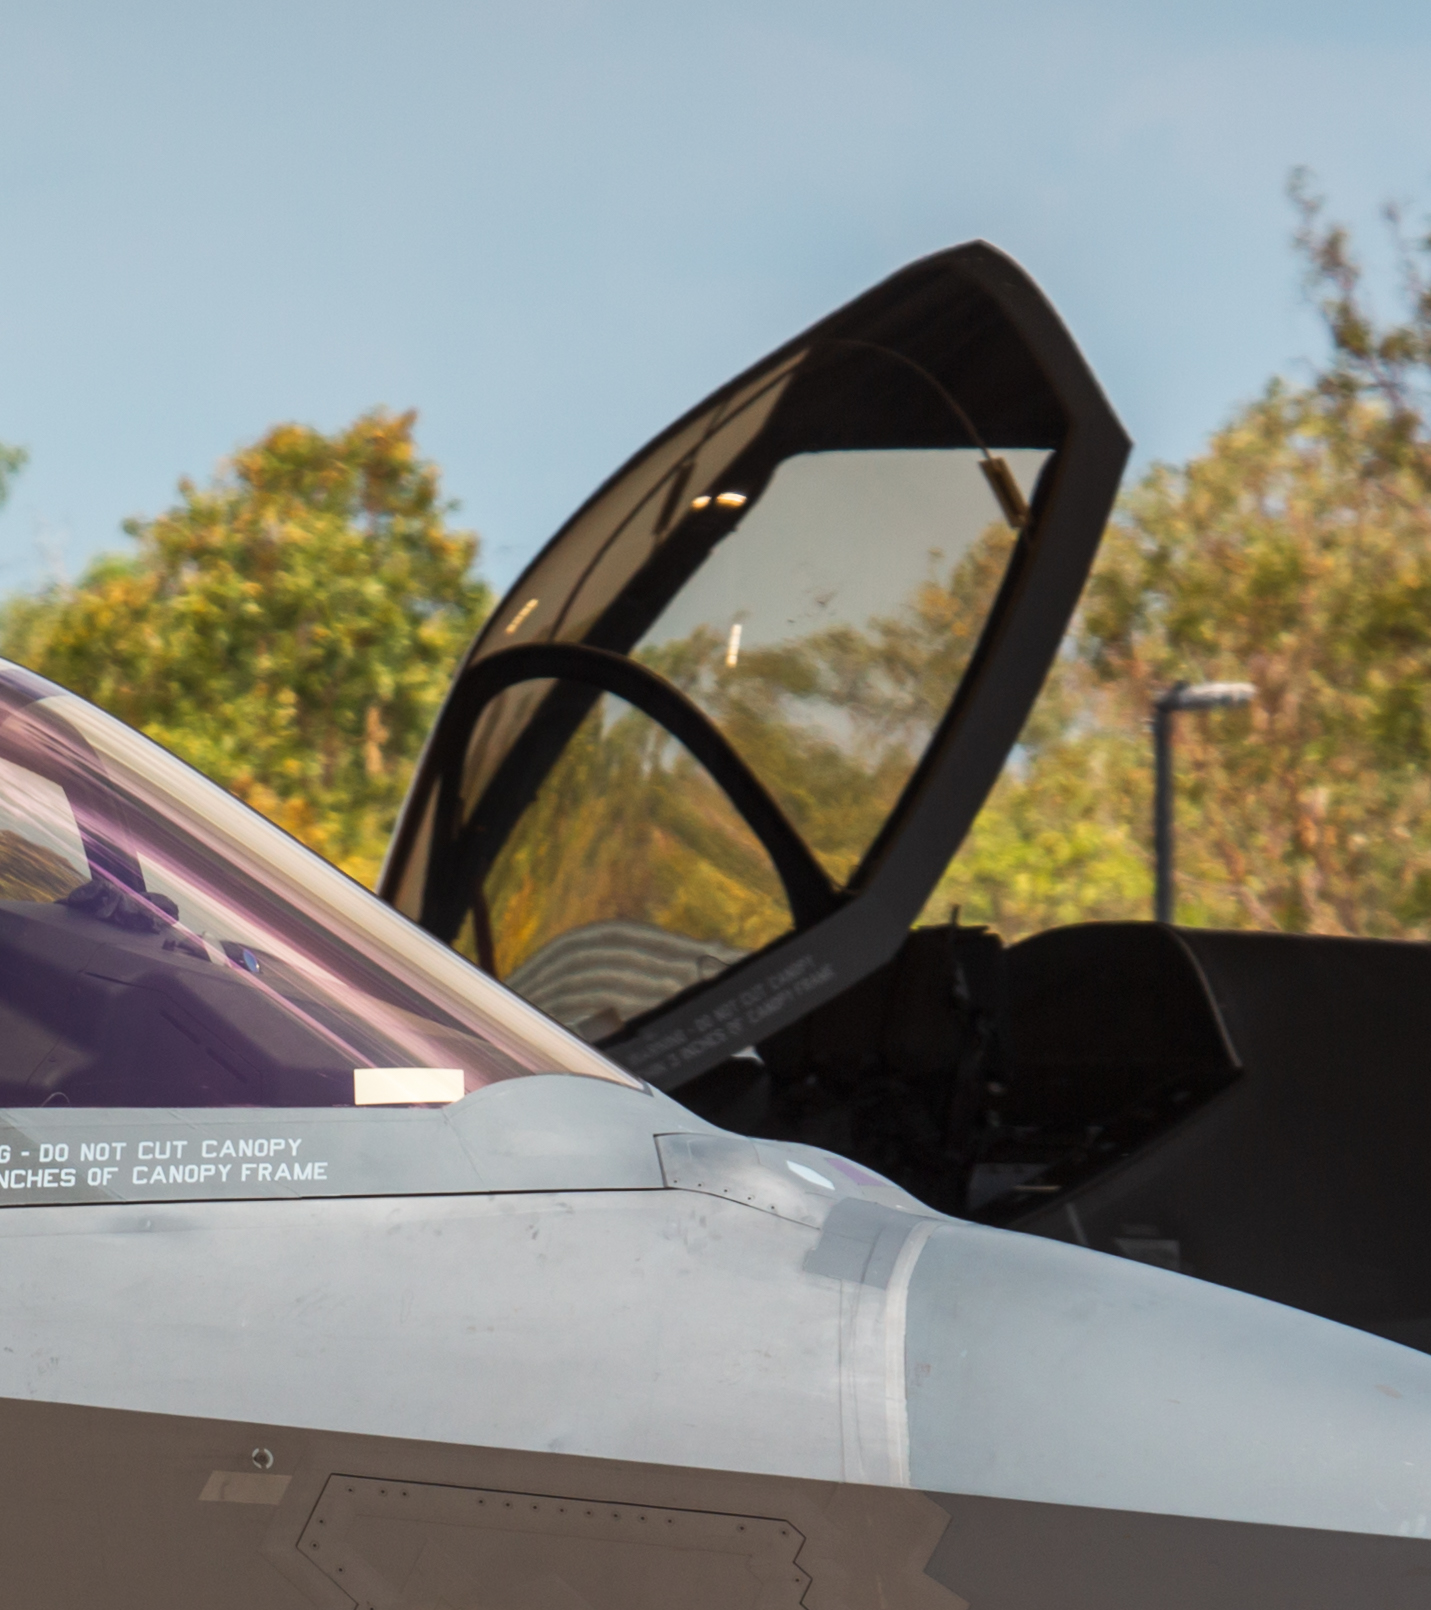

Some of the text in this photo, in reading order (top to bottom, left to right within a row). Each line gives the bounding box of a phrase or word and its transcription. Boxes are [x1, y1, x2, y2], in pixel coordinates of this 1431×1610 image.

[39, 1143, 69, 1163] DO
[80, 1142, 127, 1162] NOT
[137, 1140, 188, 1160] CUT
[201, 1138, 302, 1158] CANOPY
[87, 1166, 119, 1186] OF
[132, 1163, 232, 1185] CANOPY
[241, 1161, 328, 1182] FRAME
